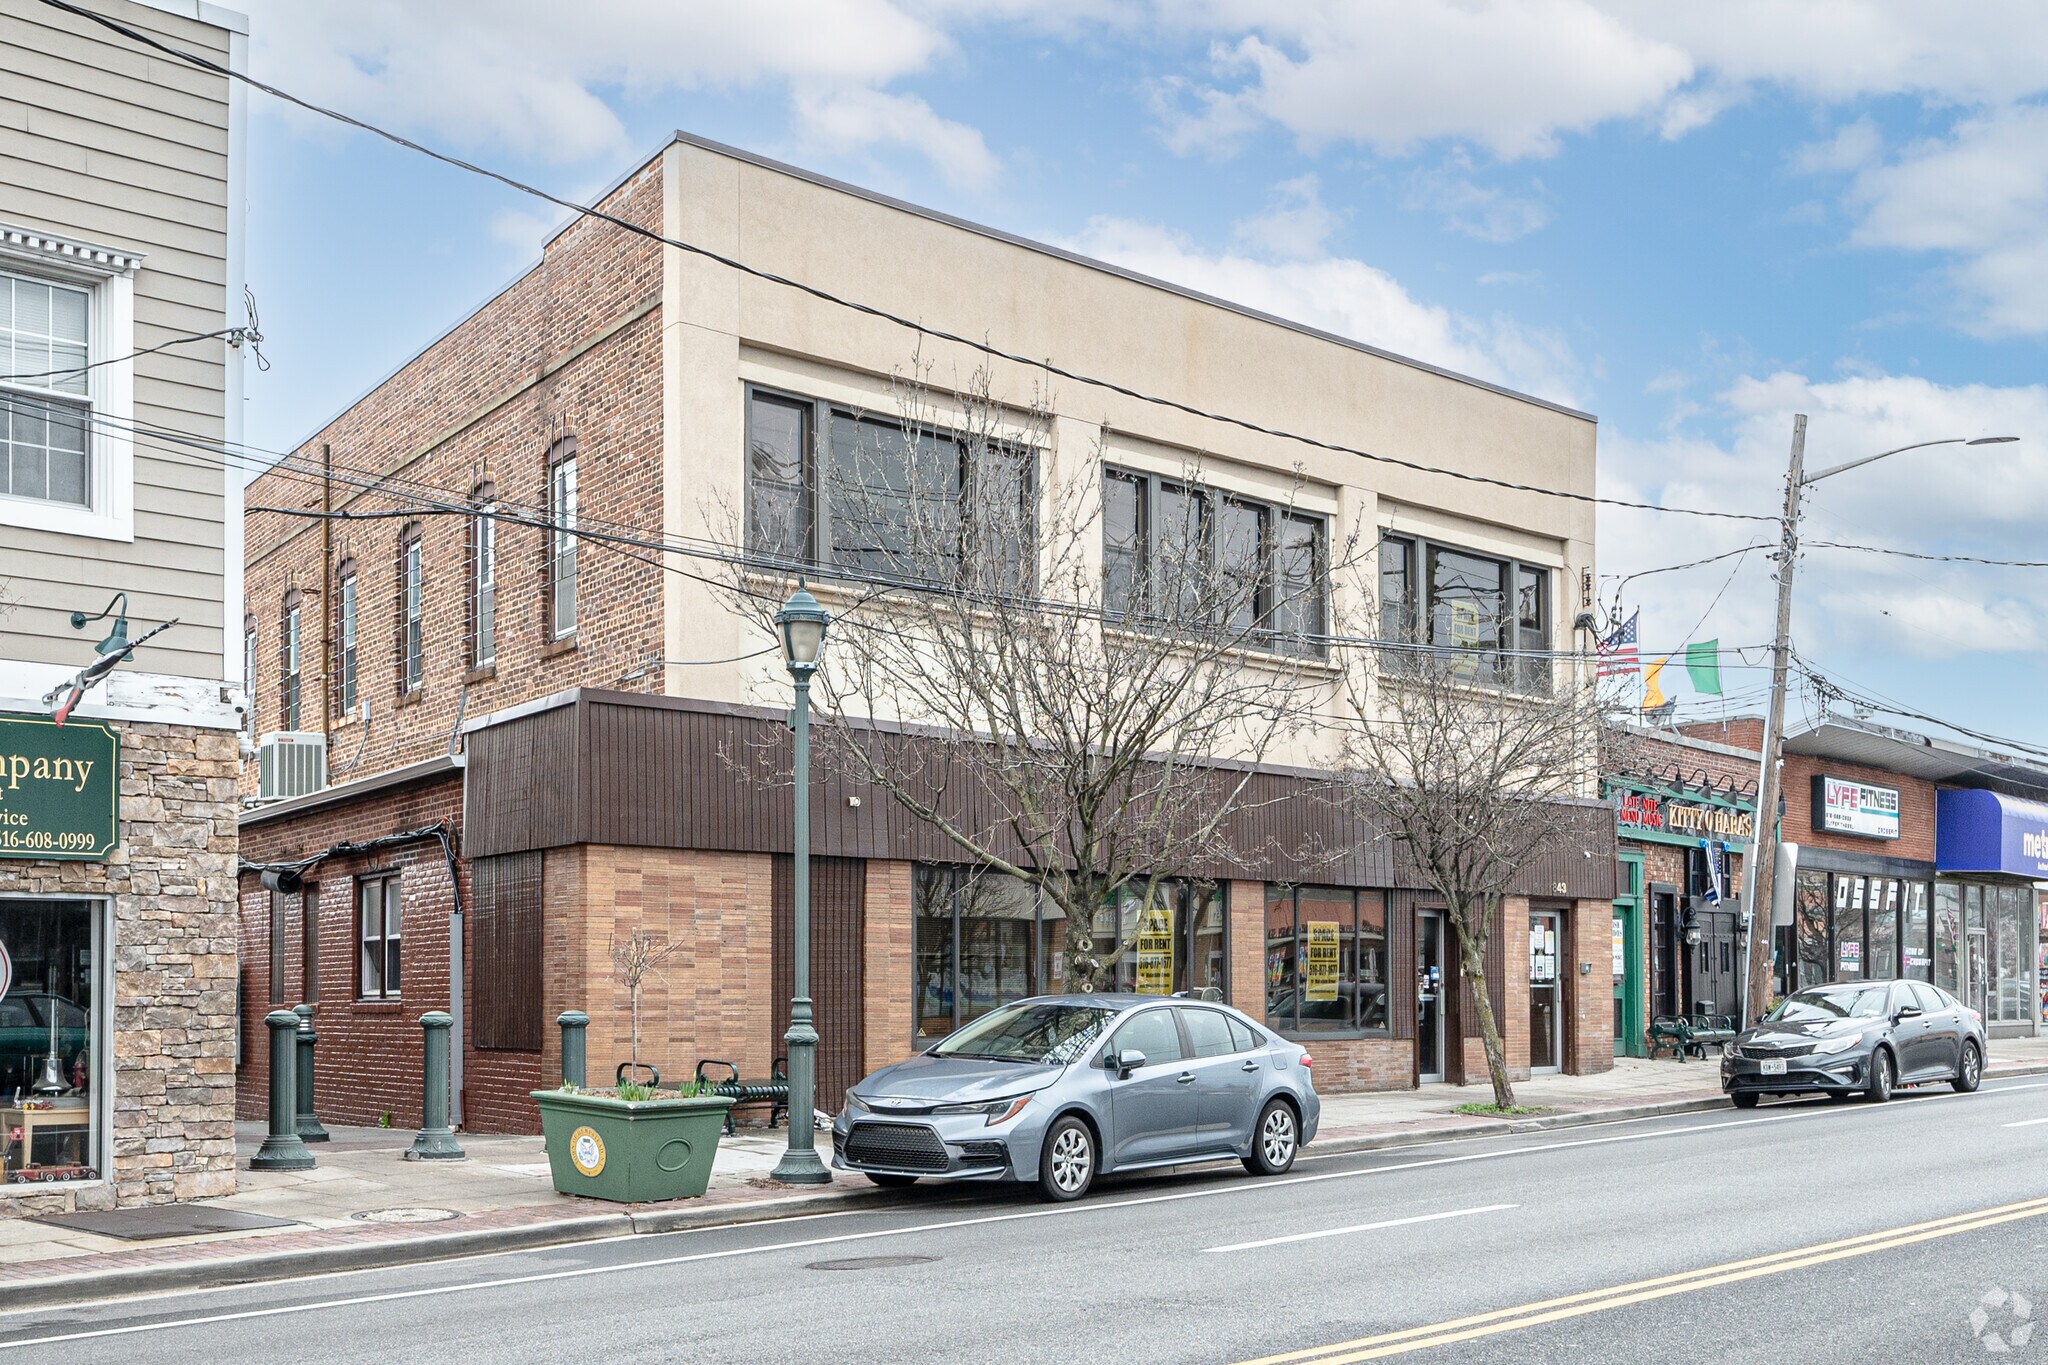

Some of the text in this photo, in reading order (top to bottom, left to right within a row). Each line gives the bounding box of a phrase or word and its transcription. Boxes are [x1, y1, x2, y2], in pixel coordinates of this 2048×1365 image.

[1623, 794, 1659, 812] LATE NITE
[1827, 784, 1897, 810] LYFE FITNESS
[1668, 803, 1704, 830] KITTY
[0, 830, 95, 850] 16-608-0999
[1553, 881, 1567, 894] 843
[1140, 938, 1171, 950] FOR RENT
[1310, 947, 1337, 958] FOR RENT
